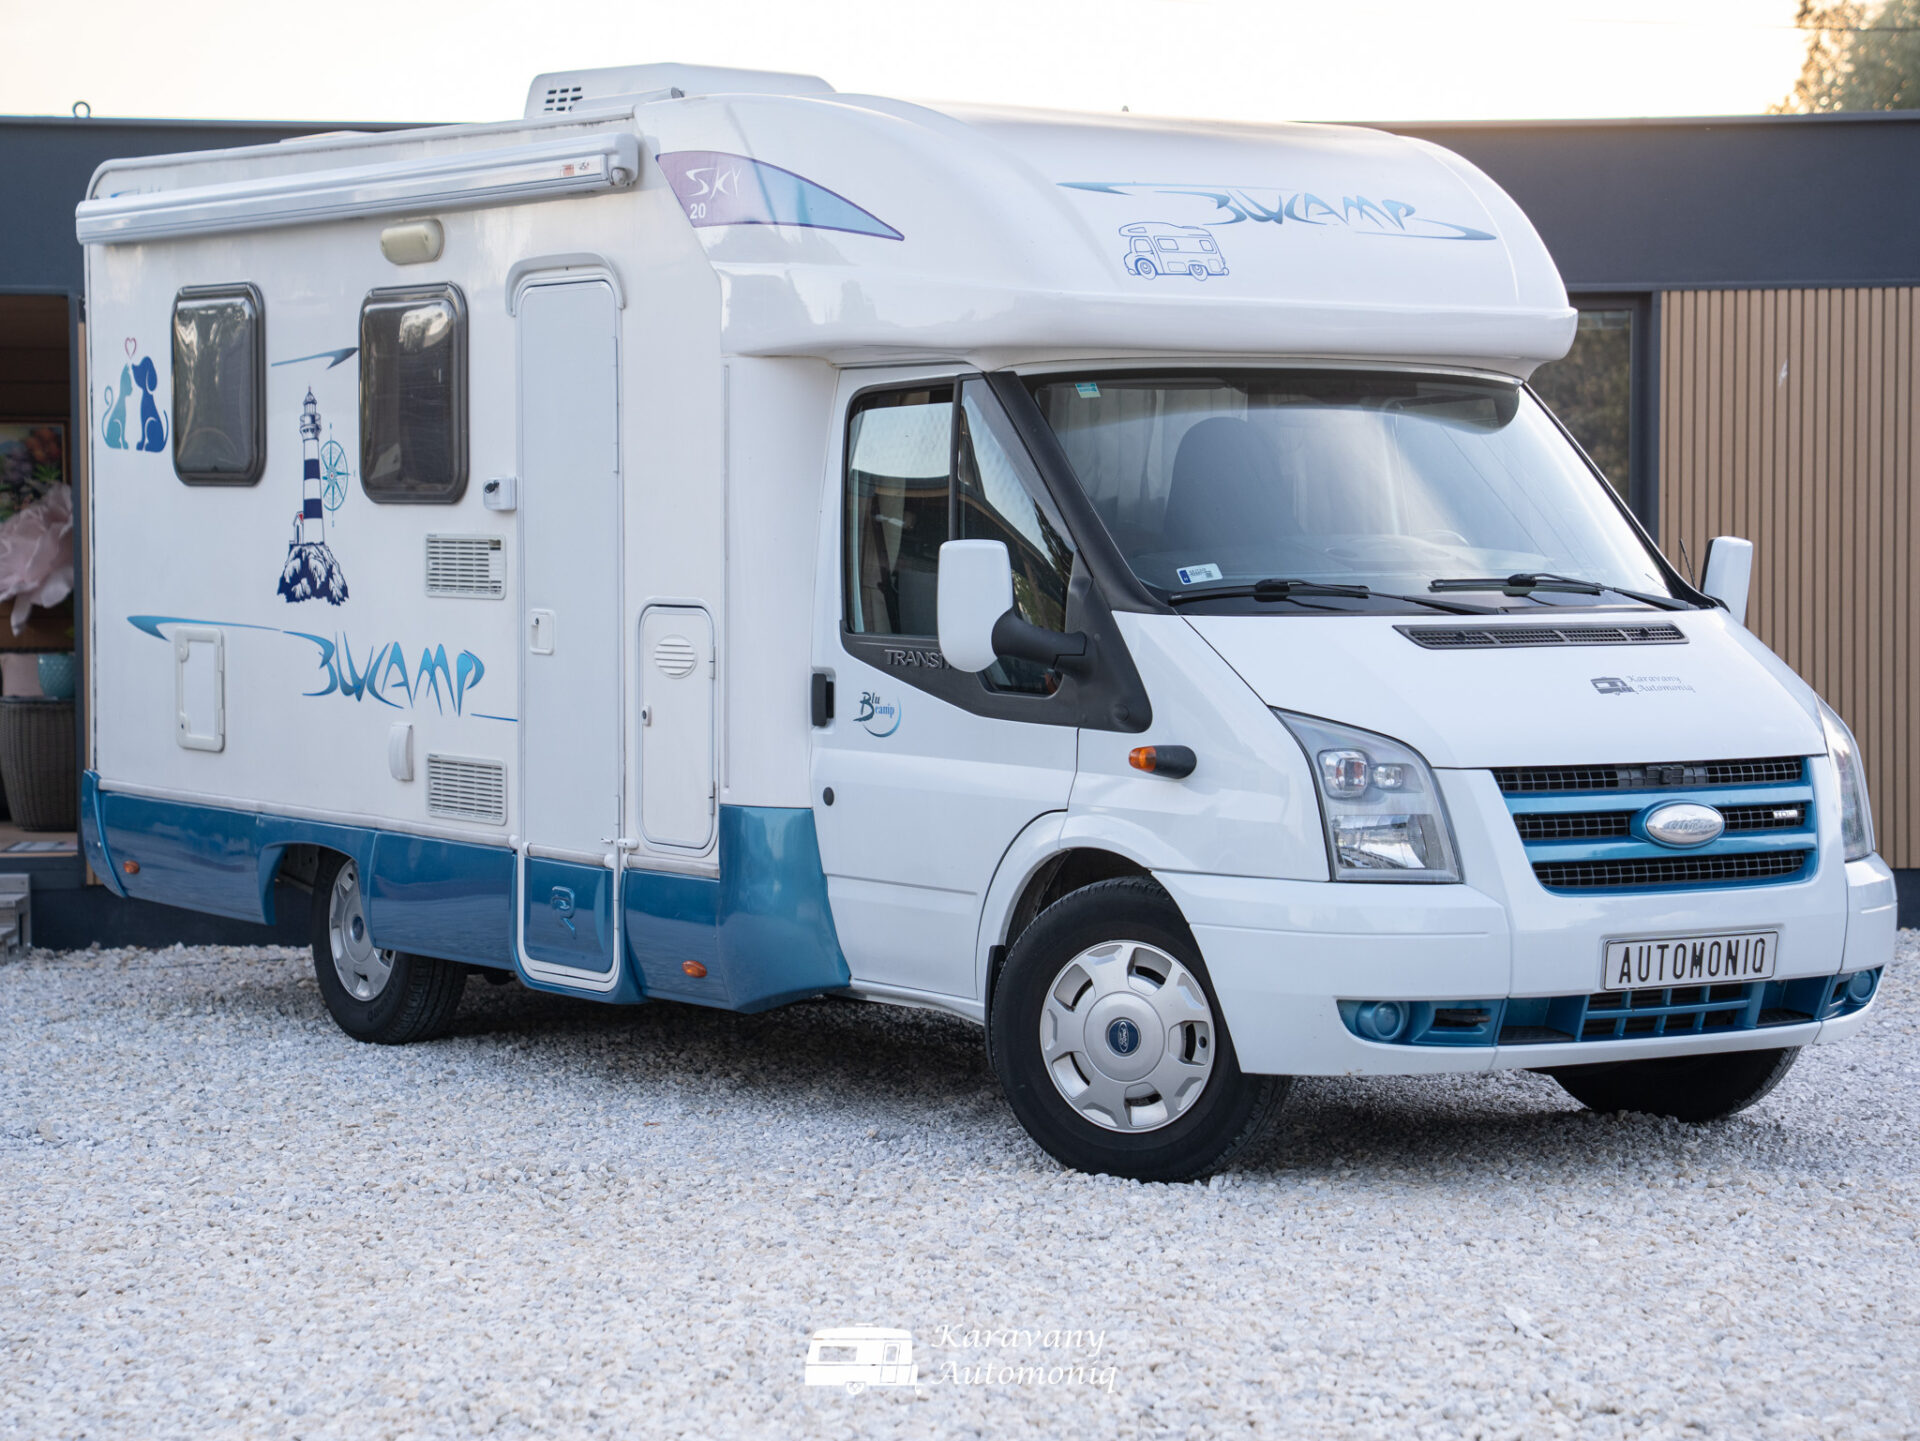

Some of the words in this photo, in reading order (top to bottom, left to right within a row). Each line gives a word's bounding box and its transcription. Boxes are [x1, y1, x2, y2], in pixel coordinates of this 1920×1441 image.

[685, 166, 743, 200] SKY
[689, 202, 707, 220] 20
[1618, 937, 1766, 984] AUTOMONIQ
